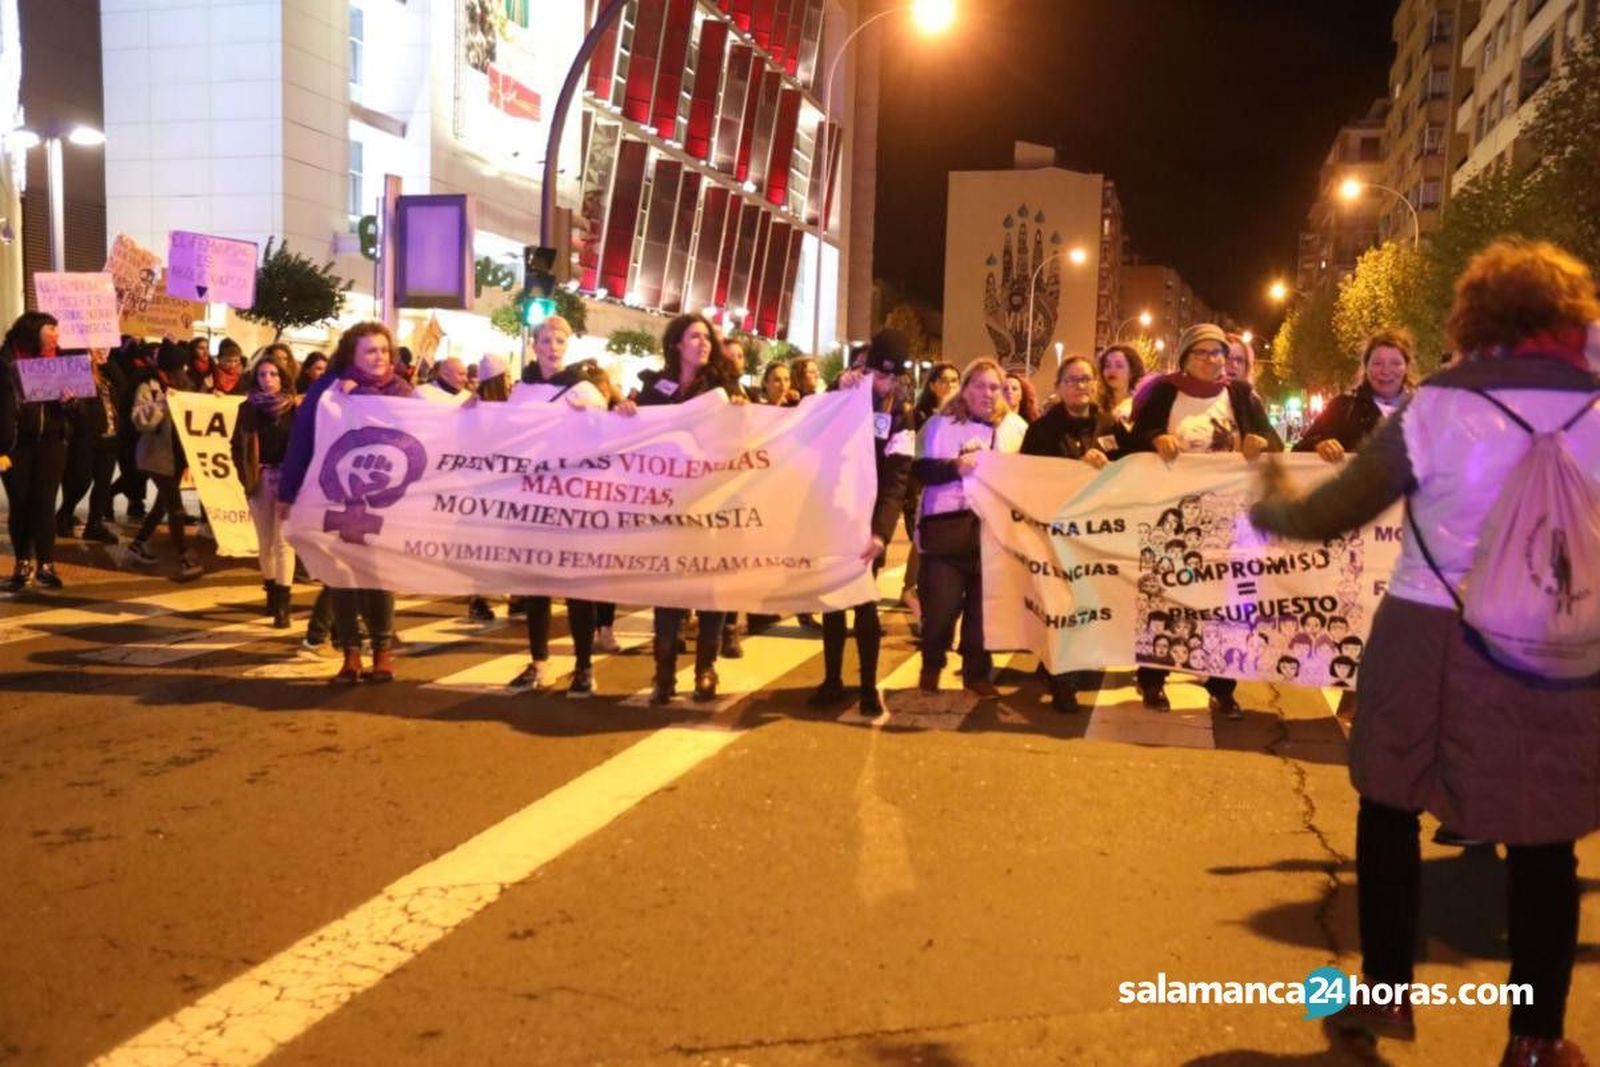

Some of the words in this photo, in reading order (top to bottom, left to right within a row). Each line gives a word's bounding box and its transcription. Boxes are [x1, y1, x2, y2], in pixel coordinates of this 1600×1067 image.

[184, 410, 229, 438] LA
[196, 451, 232, 480] ES
[436, 452, 532, 474] FRENTE
[533, 458, 550, 474] A
[558, 453, 612, 472] LAS
[431, 493, 611, 530] MOVIMIENTO
[616, 506, 764, 530] FEMINISTA
[1085, 517, 1127, 535] LAS
[403, 538, 554, 567] MOVIMIENTO
[557, 549, 671, 572] FEMINISTA
[1161, 548, 1331, 588] COMPROMISO
[1168, 594, 1339, 625] PRESUPUESTO
